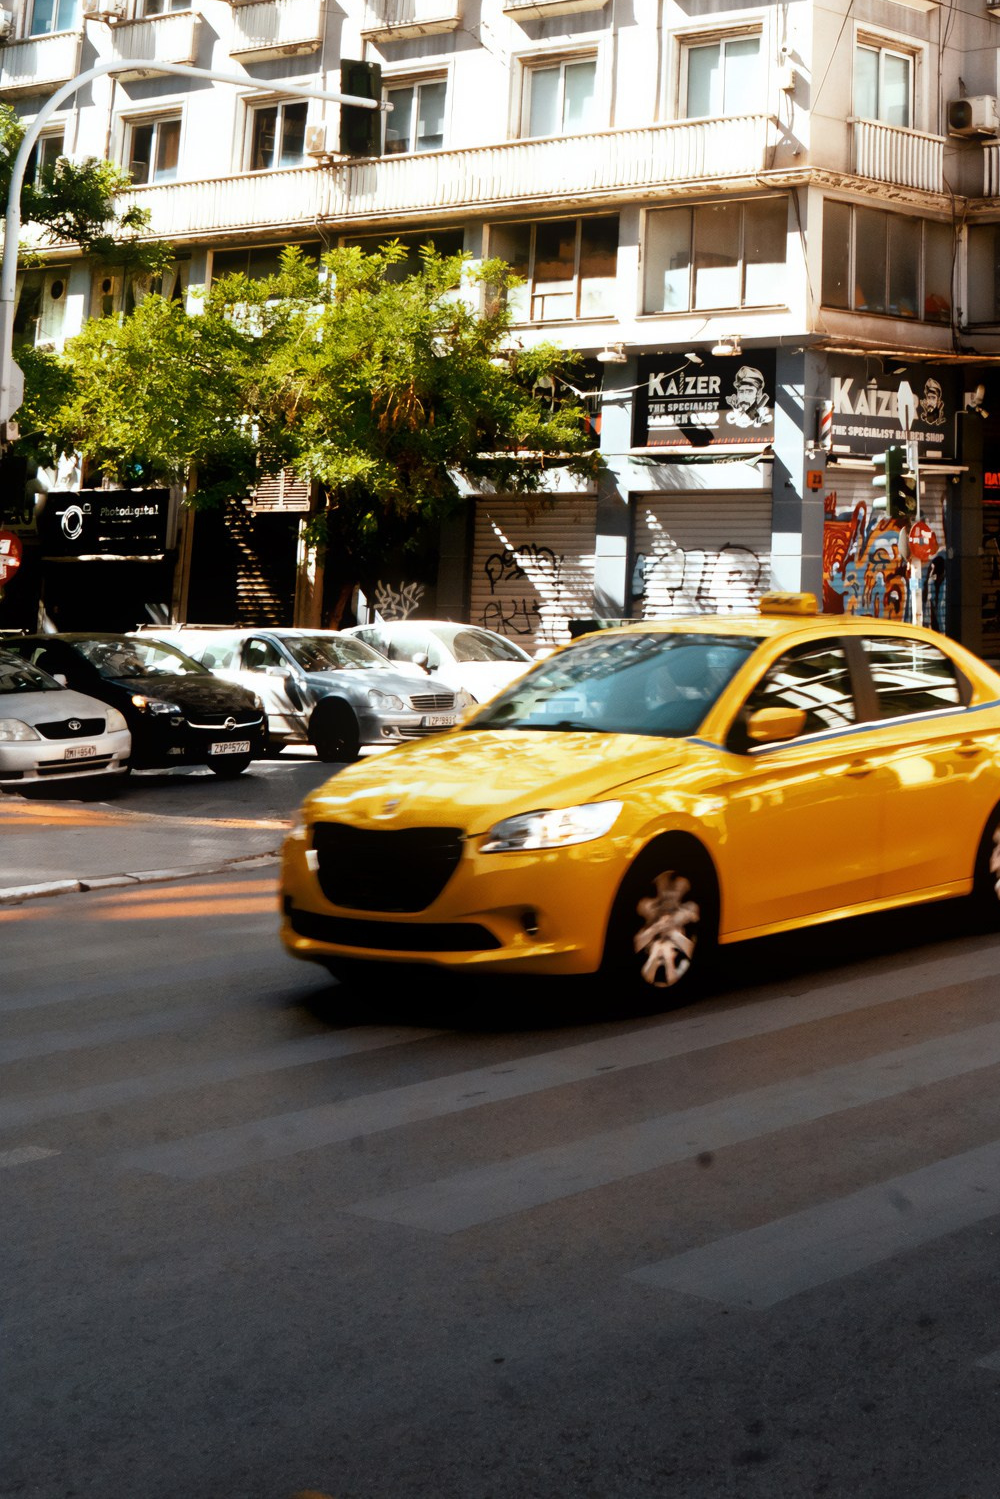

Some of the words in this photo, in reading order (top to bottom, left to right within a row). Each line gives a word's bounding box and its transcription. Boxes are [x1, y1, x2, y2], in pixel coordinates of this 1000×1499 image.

[648, 371, 721, 397] KAIZER
[648, 404, 665, 413] THE
[668, 402, 719, 412] SPECIALIST
[831, 425, 847, 436] THE
[848, 426, 894, 439] SPECIALIST
[895, 430, 924, 441] BABER
[926, 432, 945, 443] SHOP
[100, 504, 159, 518] Photodigital
